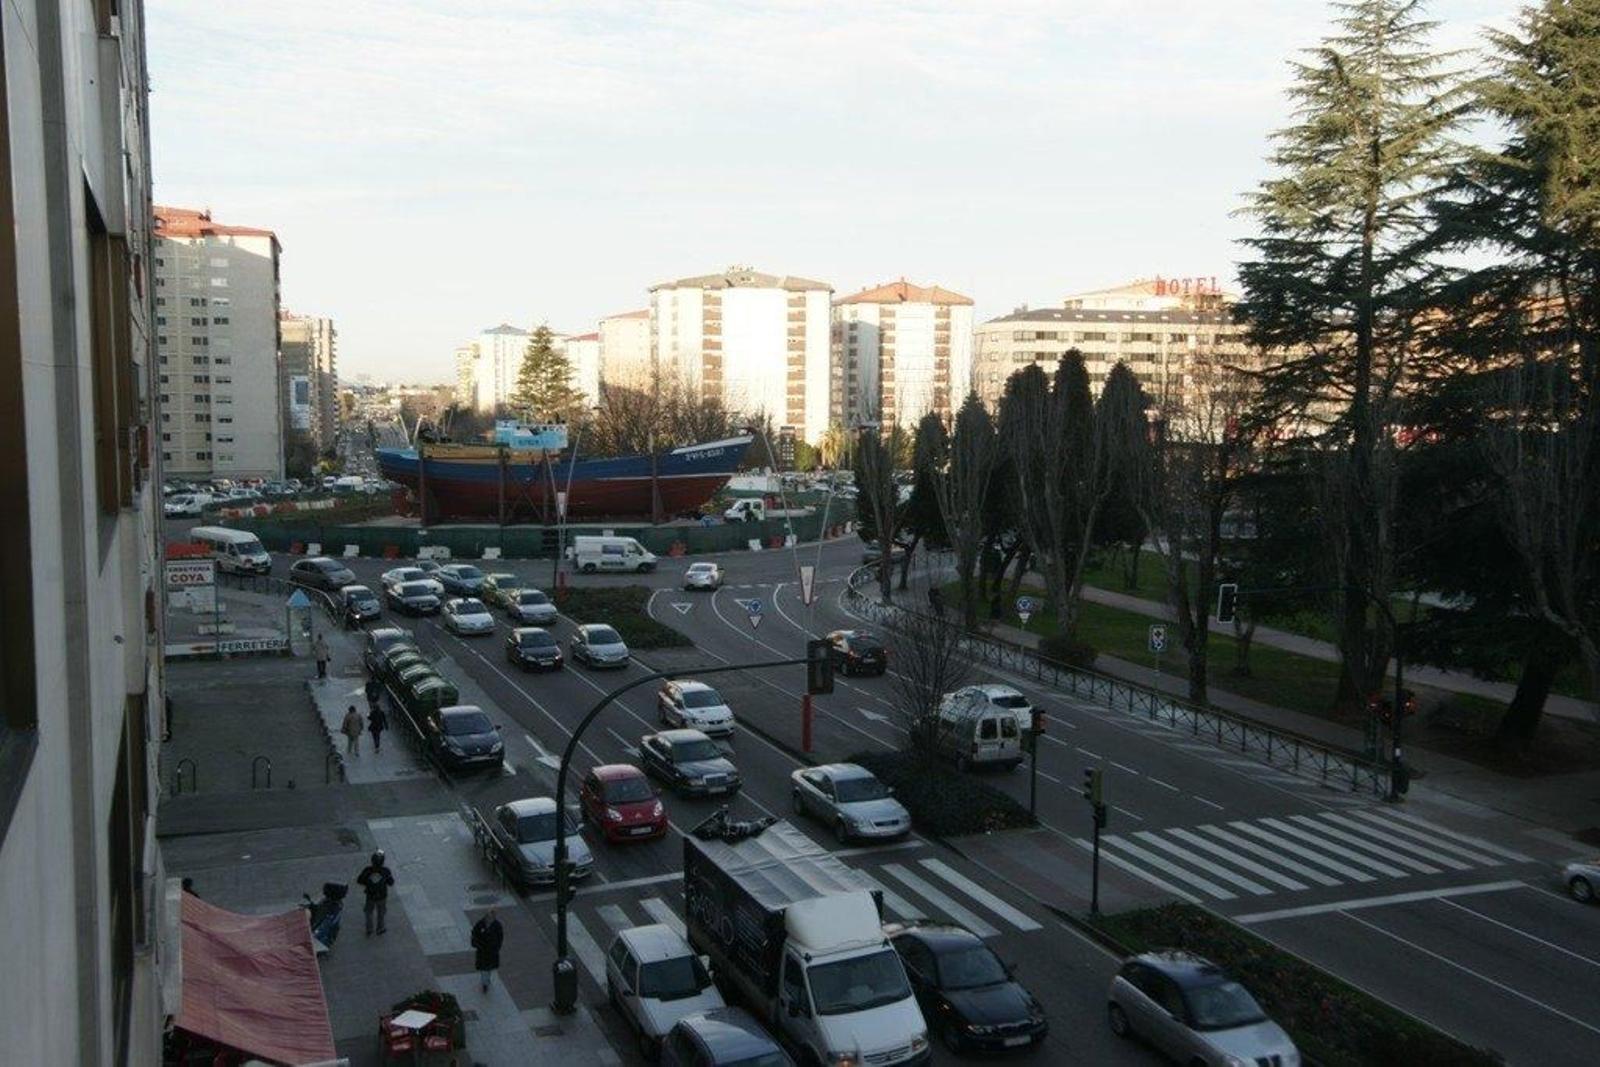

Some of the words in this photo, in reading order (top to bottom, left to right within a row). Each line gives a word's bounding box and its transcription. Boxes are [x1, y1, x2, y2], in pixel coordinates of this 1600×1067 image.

[1155, 277, 1221, 296] HOTEL
[170, 573, 205, 583] COYA
[221, 639, 290, 651] FERRETERIA
